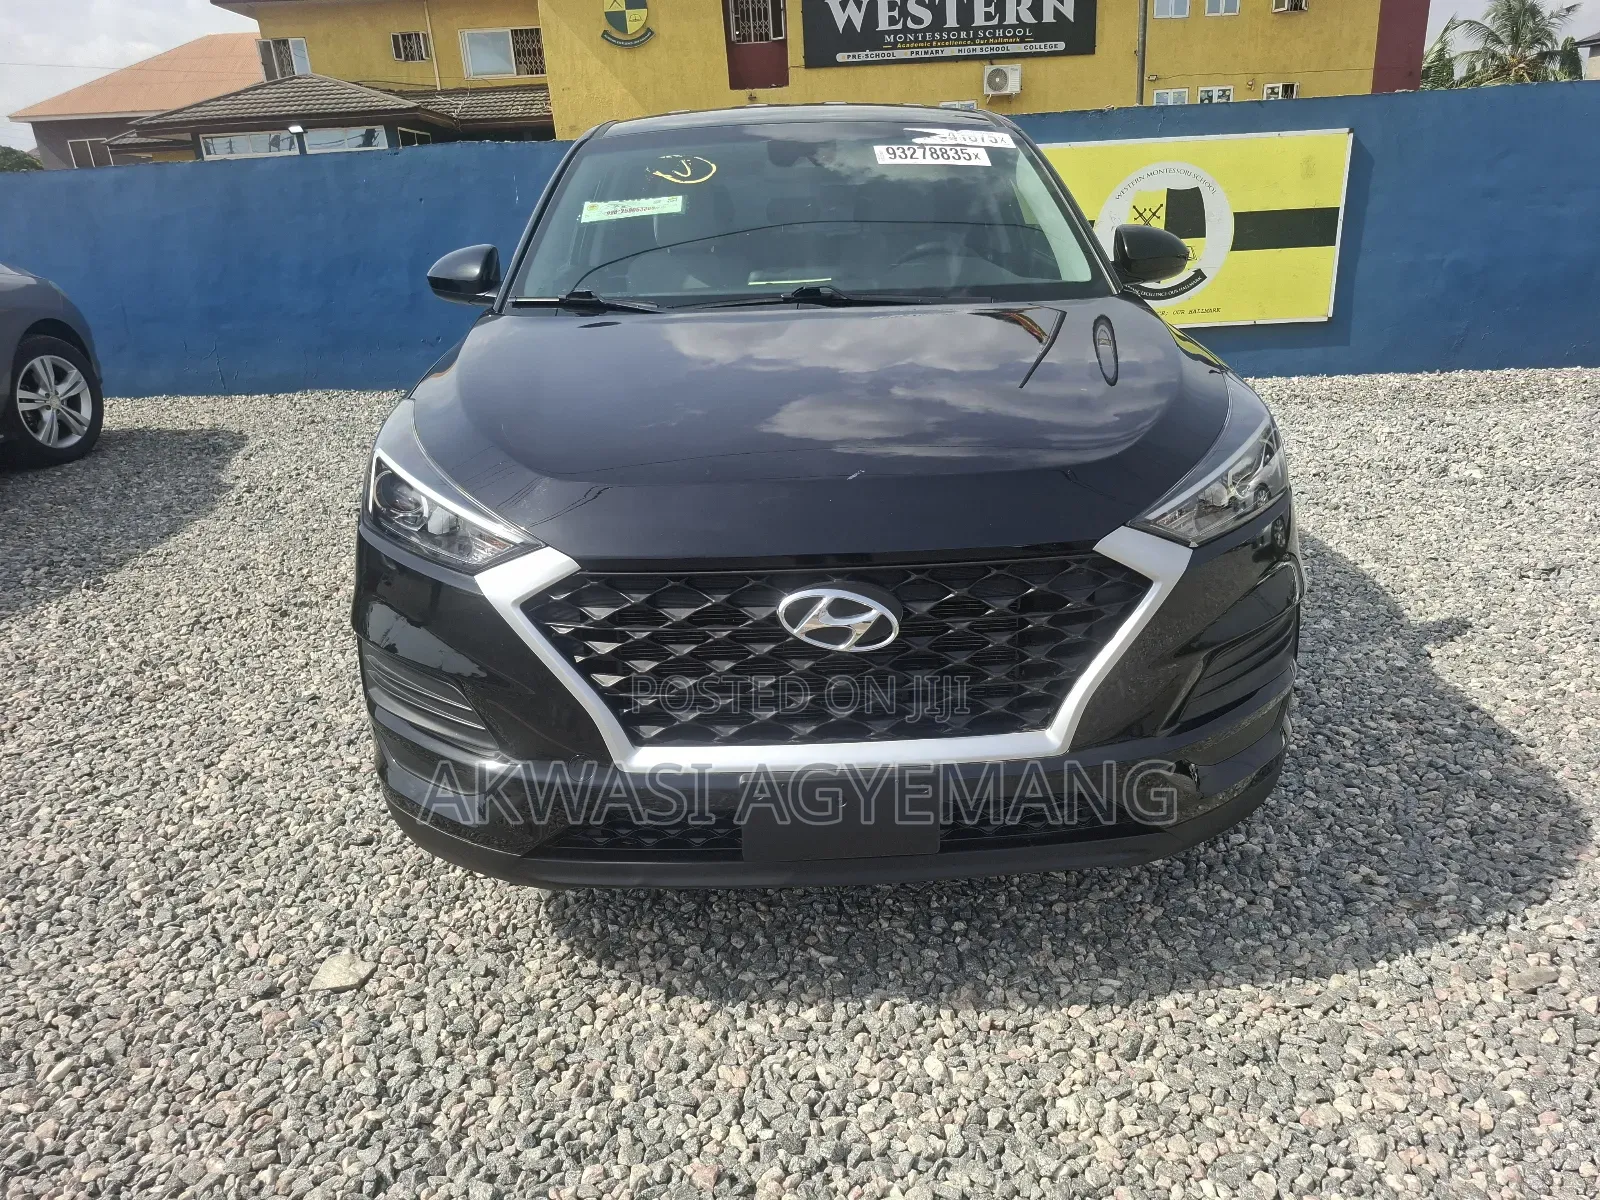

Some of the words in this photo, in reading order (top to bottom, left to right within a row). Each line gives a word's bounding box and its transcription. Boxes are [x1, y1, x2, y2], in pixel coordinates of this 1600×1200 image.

[824, 0, 1075, 34] WESTERN
[884, 30, 975, 43] MONTESSORI
[978, 27, 1033, 38] SCHOOL
[896, 41, 931, 49] Academic
[989, 36, 1021, 44] Hallmark
[846, 50, 897, 60] PRE-SCHOOL
[910, 49, 945, 57] PRIMARY
[979, 45, 1011, 53] SCHOOL
[1023, 43, 1059, 51] COLLEGE
[1115, 174, 1145, 200] WESTERN
[1146, 167, 1192, 178] MONTESSORI
[1192, 173, 1217, 195] SCHOOL
[1178, 275, 1203, 292] HALLMARK
